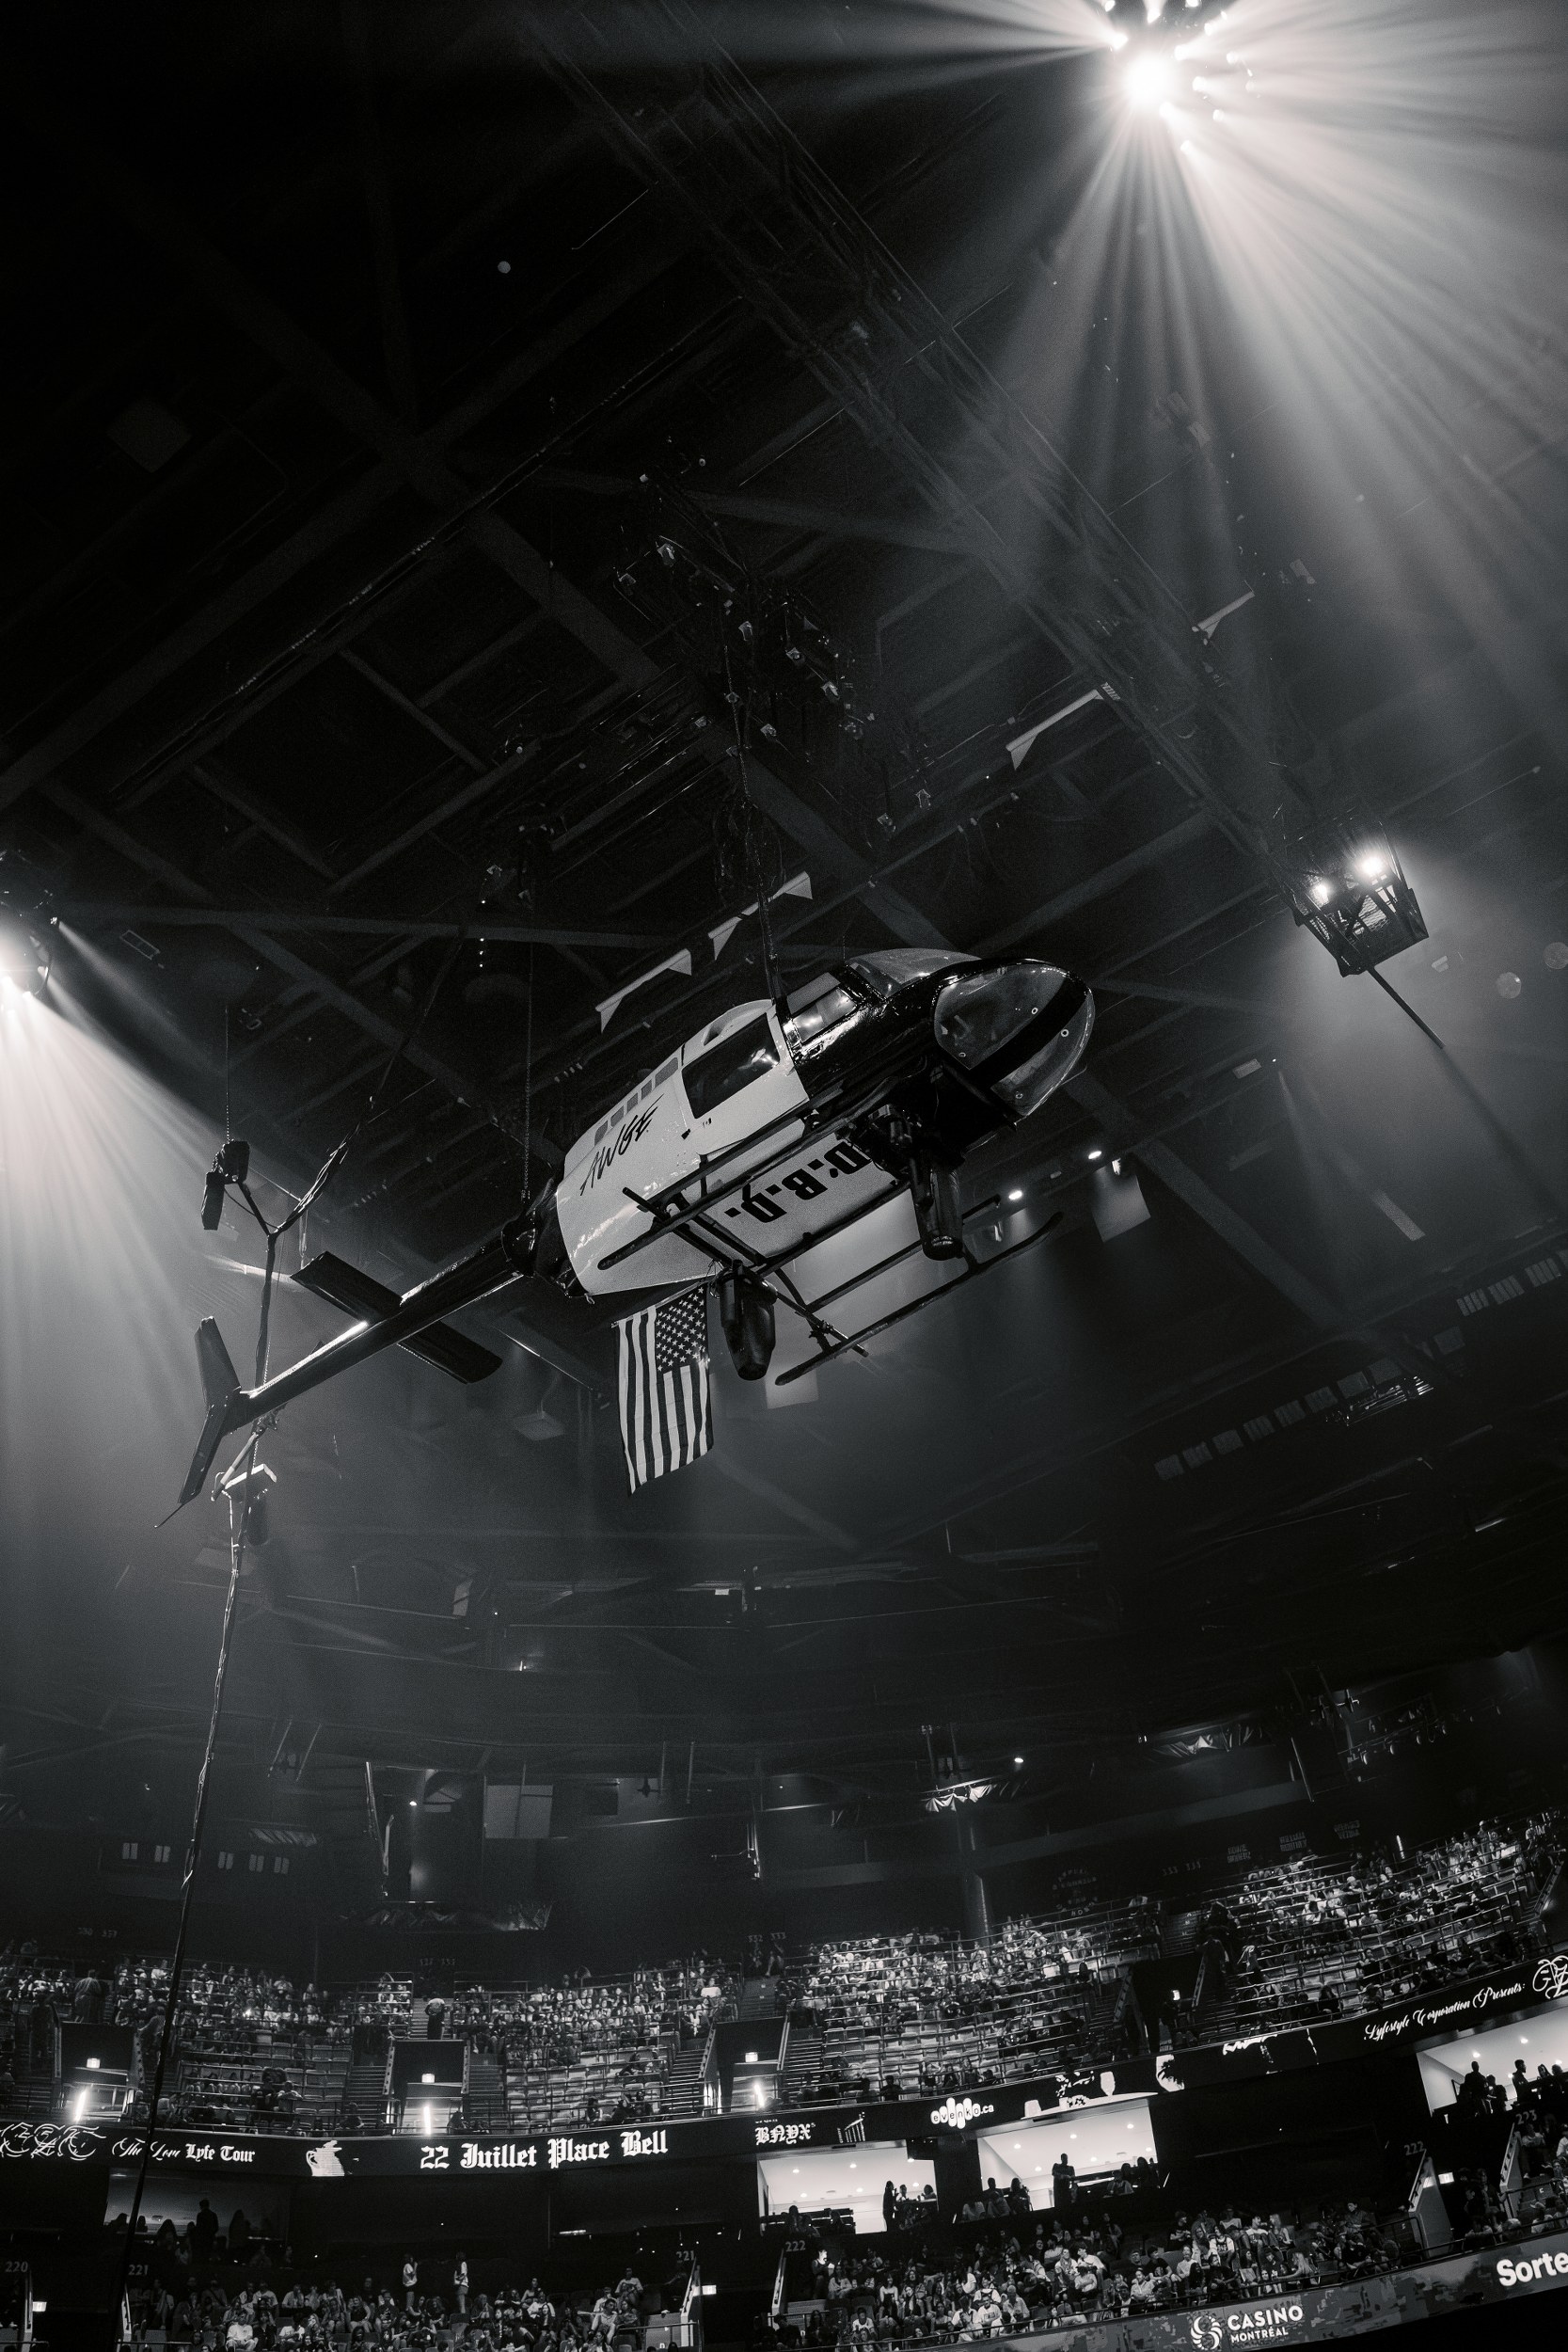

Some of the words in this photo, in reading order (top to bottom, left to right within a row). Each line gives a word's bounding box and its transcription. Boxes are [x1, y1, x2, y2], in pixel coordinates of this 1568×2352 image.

[1364, 2015, 1410, 2042] Lyfestyle
[1413, 1999, 1470, 2026] Corporation
[1473, 1982, 1526, 2009] Presents:
[931, 2101, 994, 2125] evenko.ca
[112, 2137, 146, 2158] The
[185, 2143, 214, 2162] Lyfe
[220, 2145, 255, 2163] Tour
[420, 2146, 450, 2169] 22
[460, 2143, 537, 2169] Juillet
[547, 2137, 610, 2169] Place
[620, 2129, 668, 2157] Bell
[1403, 2140, 1425, 2156] 222
[784, 2240, 806, 2252] 222
[675, 2249, 695, 2264] 221
[5, 2260, 28, 2273] 220
[128, 2264, 149, 2276] 221
[1227, 2305, 1304, 2331] CASINO
[1230, 2327, 1289, 2344] MONTRÉAL
